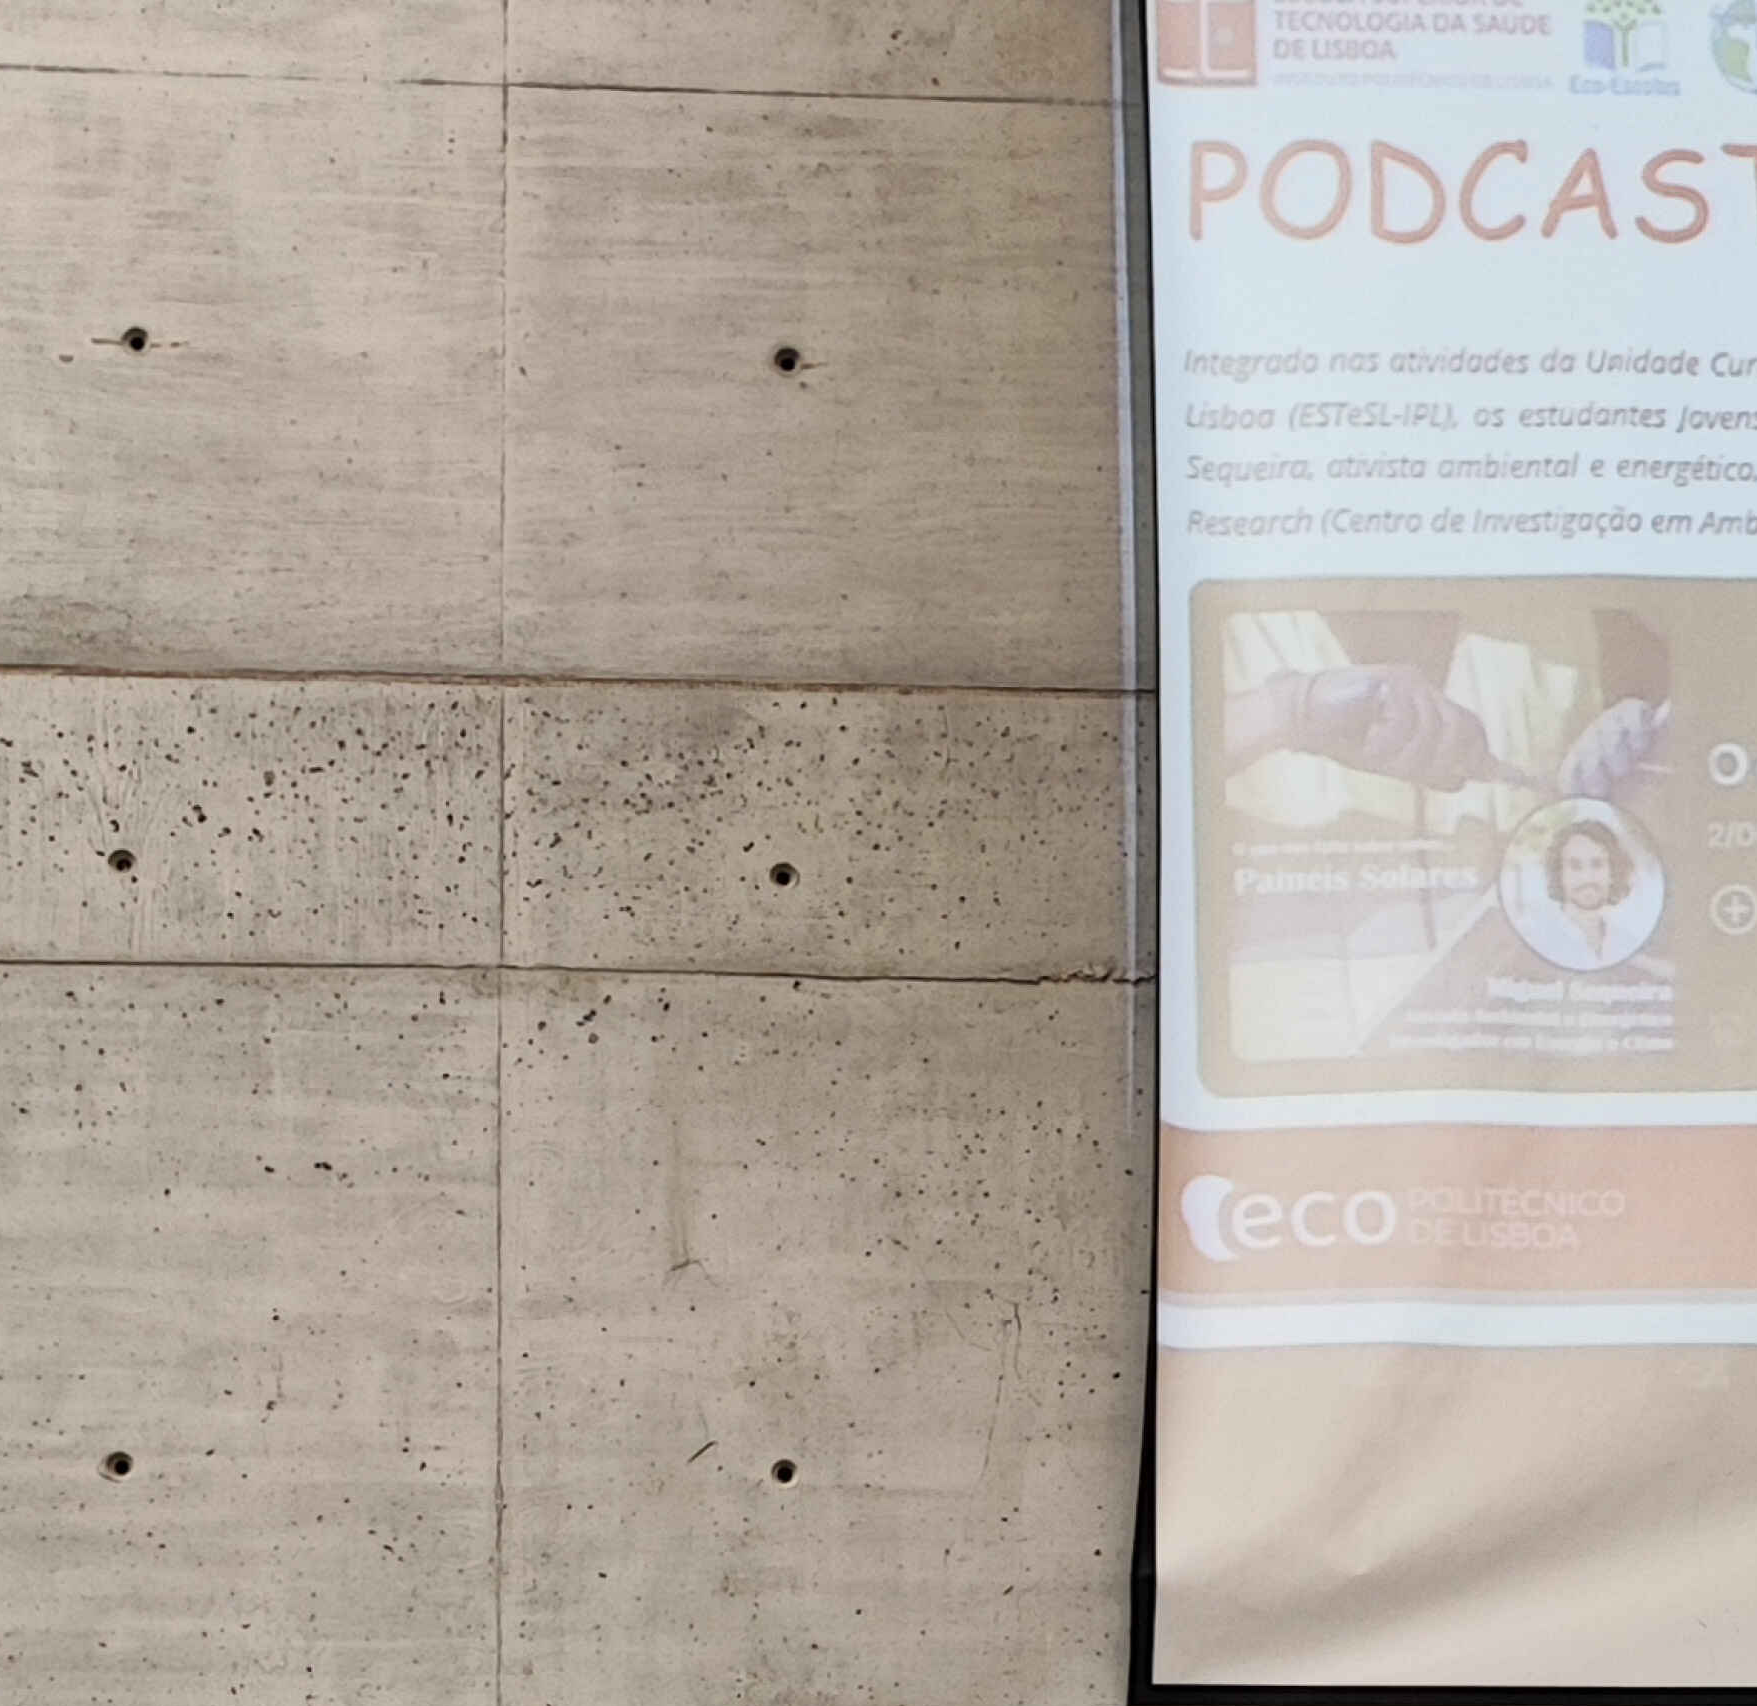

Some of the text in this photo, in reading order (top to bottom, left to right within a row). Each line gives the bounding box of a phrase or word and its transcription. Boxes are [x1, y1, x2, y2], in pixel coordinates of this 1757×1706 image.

[1274, 10, 1424, 32] TECNOLOGIA
[1433, 12, 1465, 34] DA
[1273, 39, 1397, 61] DE LISBOA
[1183, 350, 1319, 382] Integrado
[1329, 354, 1380, 374] nas
[1392, 350, 1530, 375] atividades
[1539, 351, 1576, 375] da
[1587, 351, 1700, 376] Unidade
[1183, 403, 1276, 430] Lisboa
[1474, 408, 1505, 429] os
[1518, 404, 1667, 430] estudantes
[1708, 744, 1746, 786] O
[1231, 1190, 1397, 1248] eco
